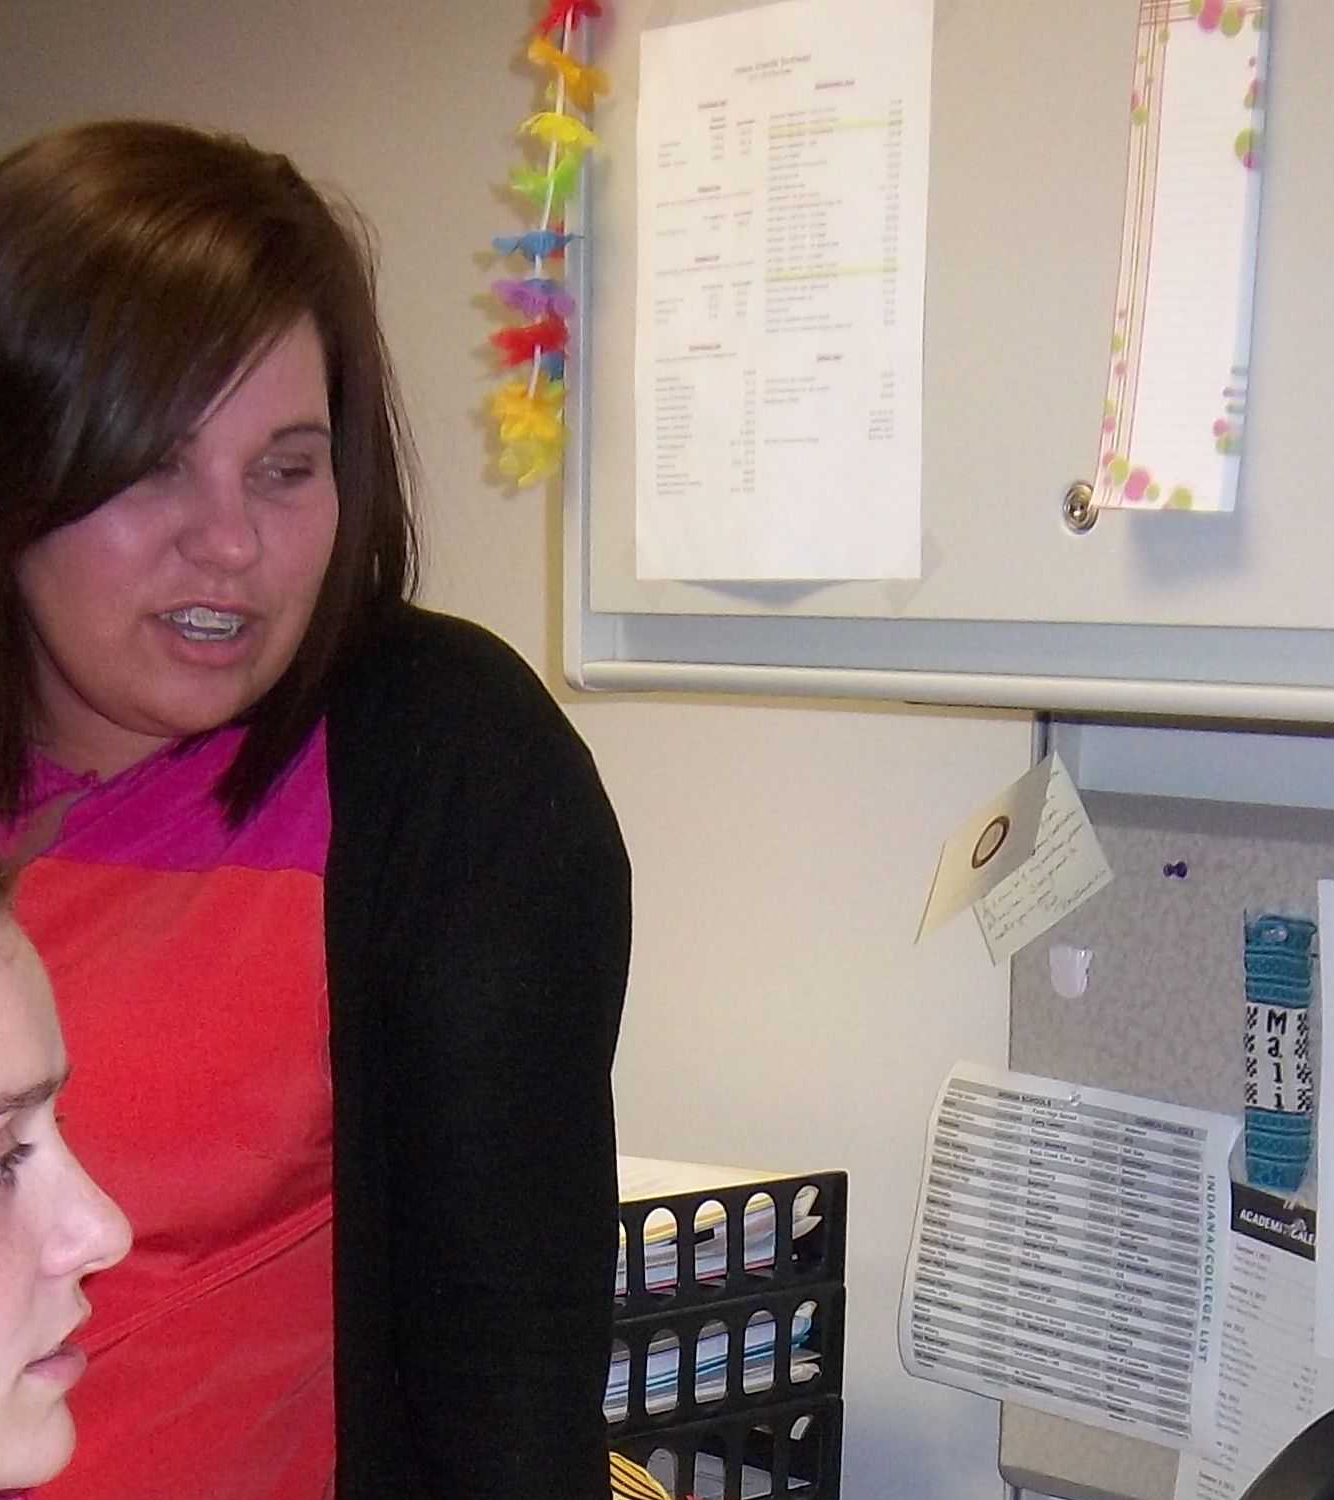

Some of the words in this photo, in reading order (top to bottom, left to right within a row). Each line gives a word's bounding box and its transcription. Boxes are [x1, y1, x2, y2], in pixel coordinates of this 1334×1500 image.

[1239, 1208, 1289, 1235] ACADEMI
[1290, 1225, 1316, 1247] CALE
[1201, 1174, 1217, 1323] INDIANA/COLLEGE
[1197, 1329, 1210, 1364] LIST
